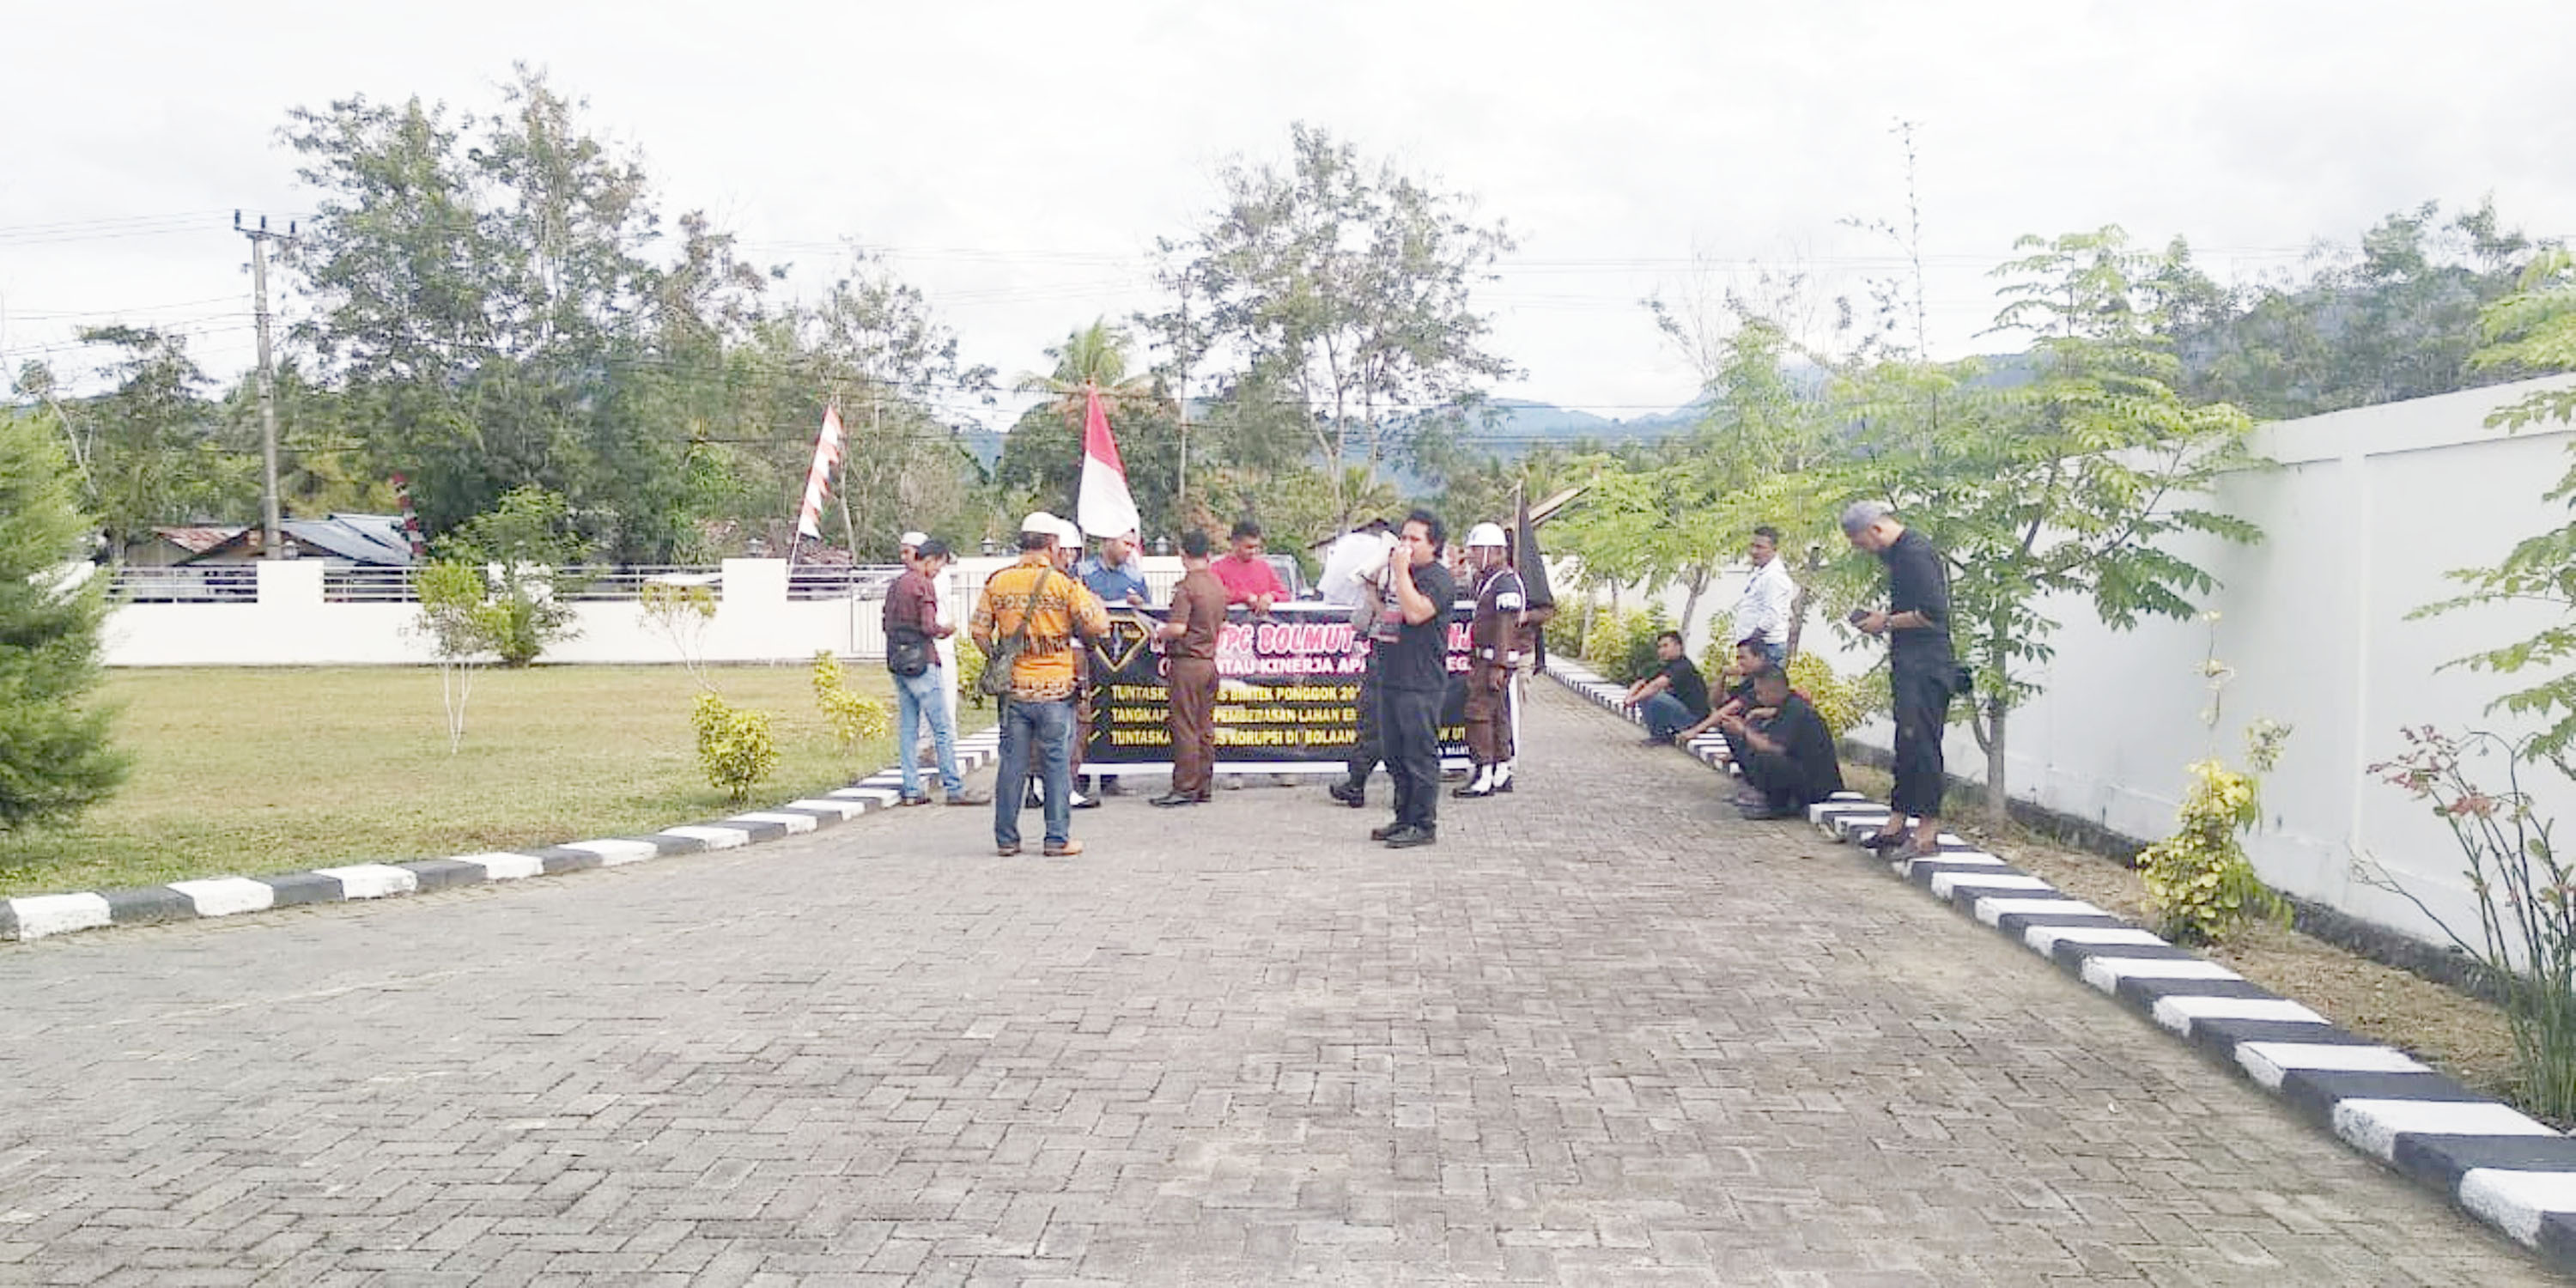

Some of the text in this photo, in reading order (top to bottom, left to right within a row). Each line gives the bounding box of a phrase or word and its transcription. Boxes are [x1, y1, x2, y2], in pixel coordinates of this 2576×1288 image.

[1257, 623, 1354, 654] BOLMUT
[1260, 657, 1334, 673] KINERJA
[1110, 684, 1170, 701] TUNTASK
[1298, 708, 1340, 722] LAHAN
[1110, 729, 1172, 745] TUNTASKA
[1285, 729, 1299, 744] DI
[1304, 728, 1357, 744] BOLAAN
